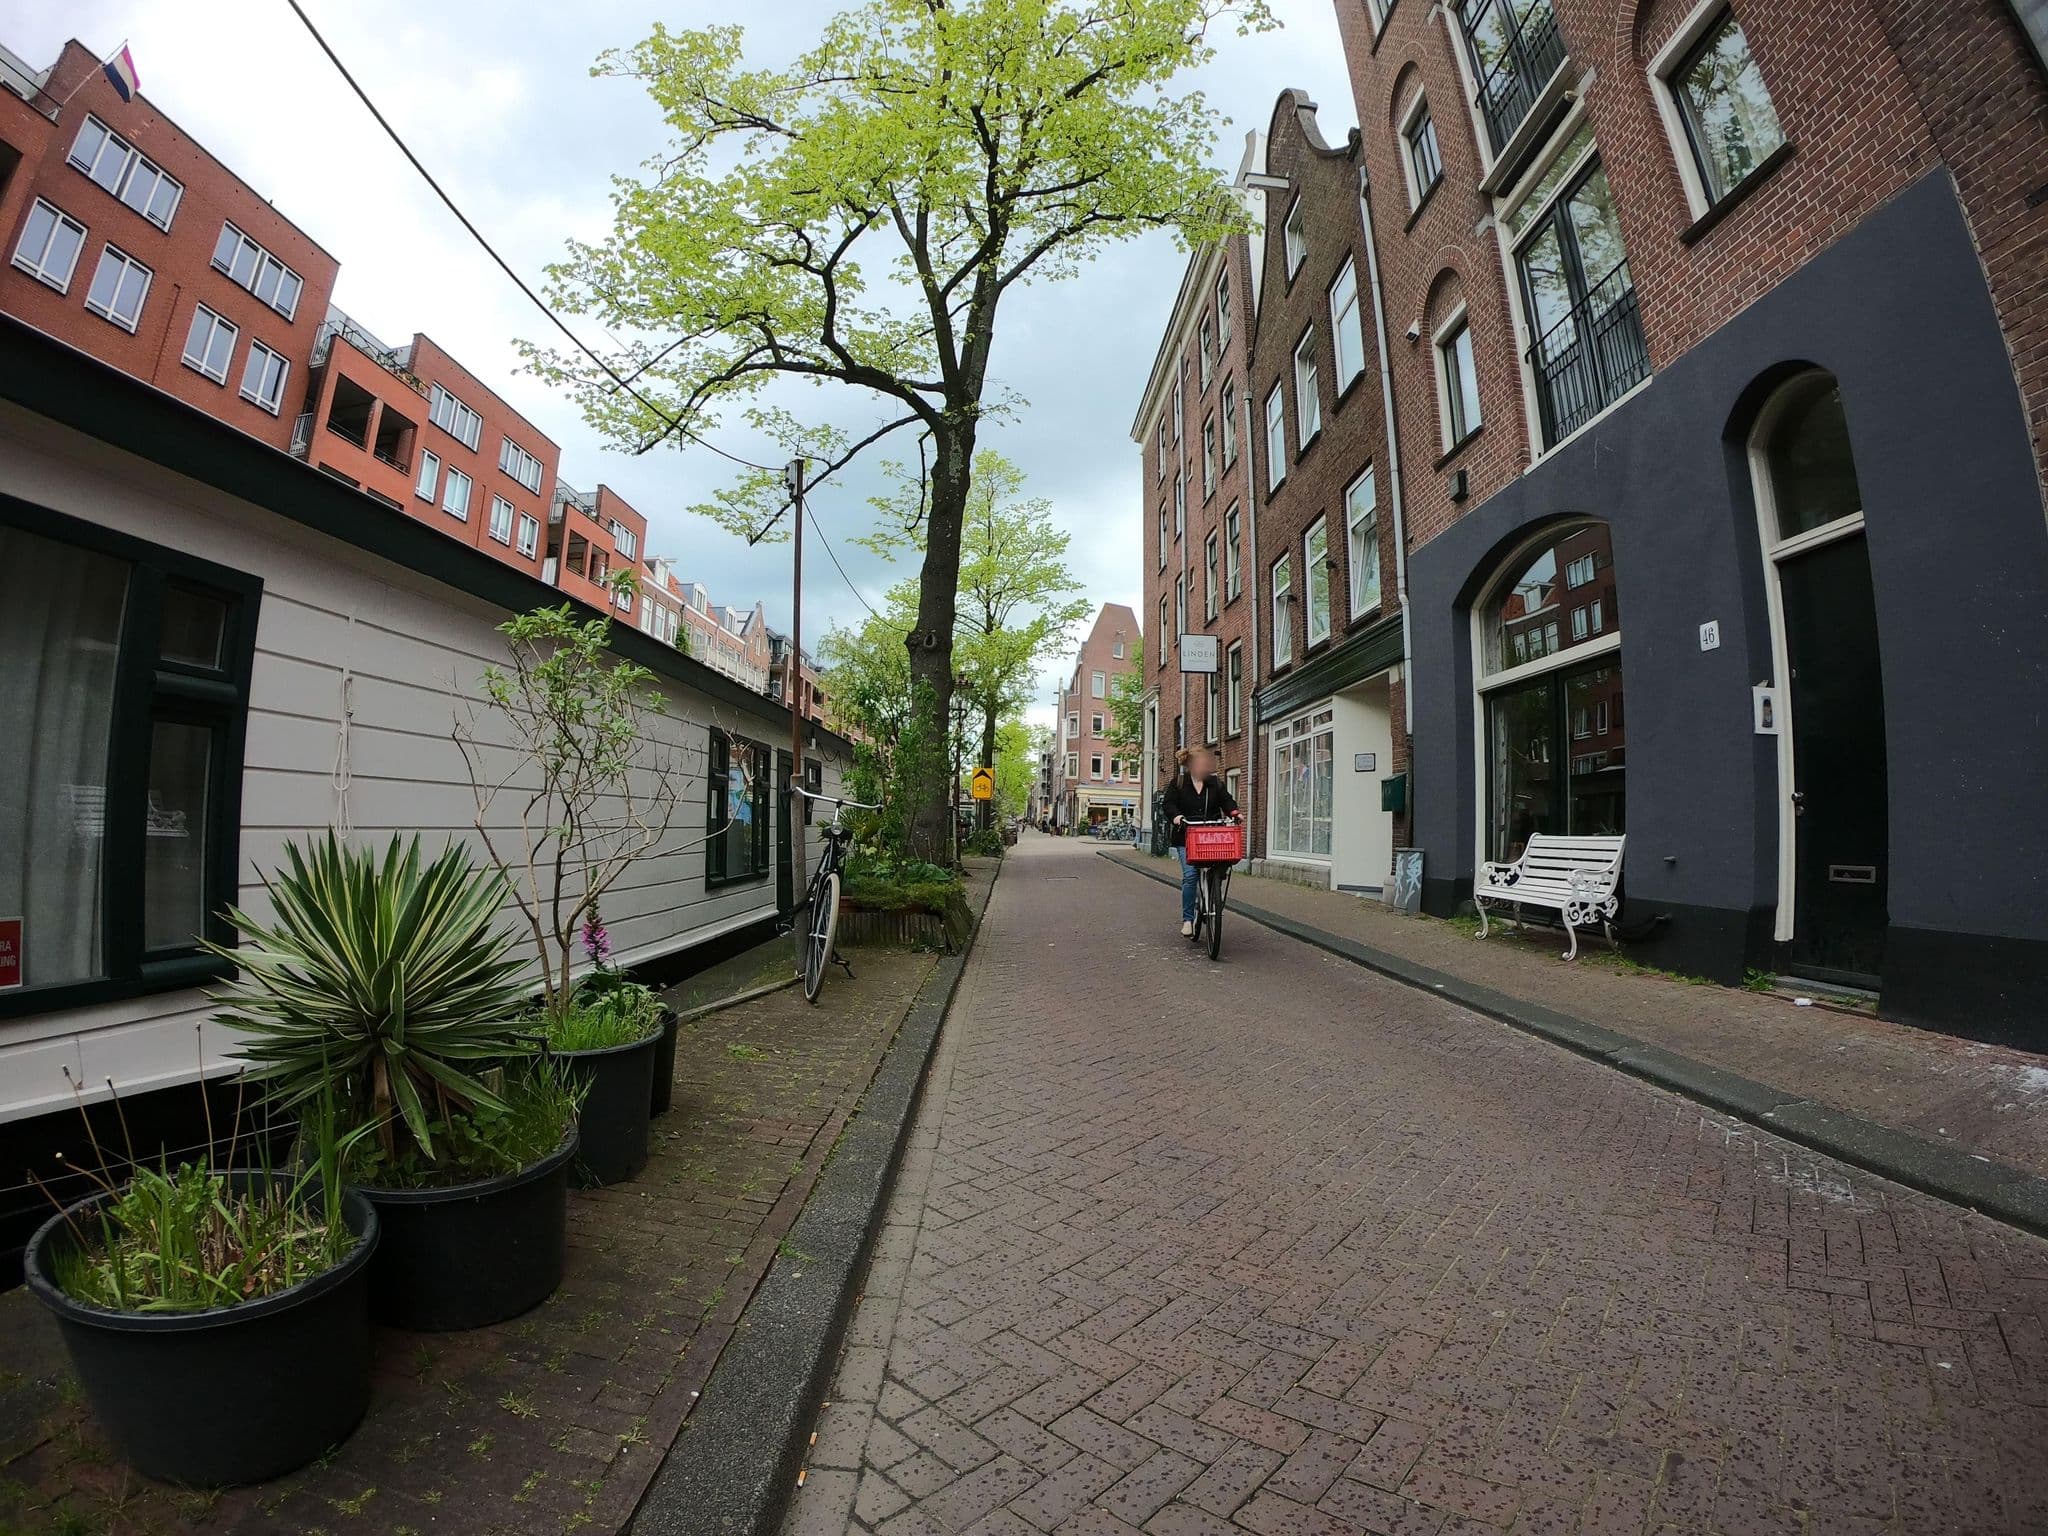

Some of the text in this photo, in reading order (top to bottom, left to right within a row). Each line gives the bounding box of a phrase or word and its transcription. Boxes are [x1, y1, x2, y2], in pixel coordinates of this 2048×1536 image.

[1703, 626, 1715, 644] 46
[1182, 650, 1216, 658] LINDEN
[0, 954, 17, 967] ING
